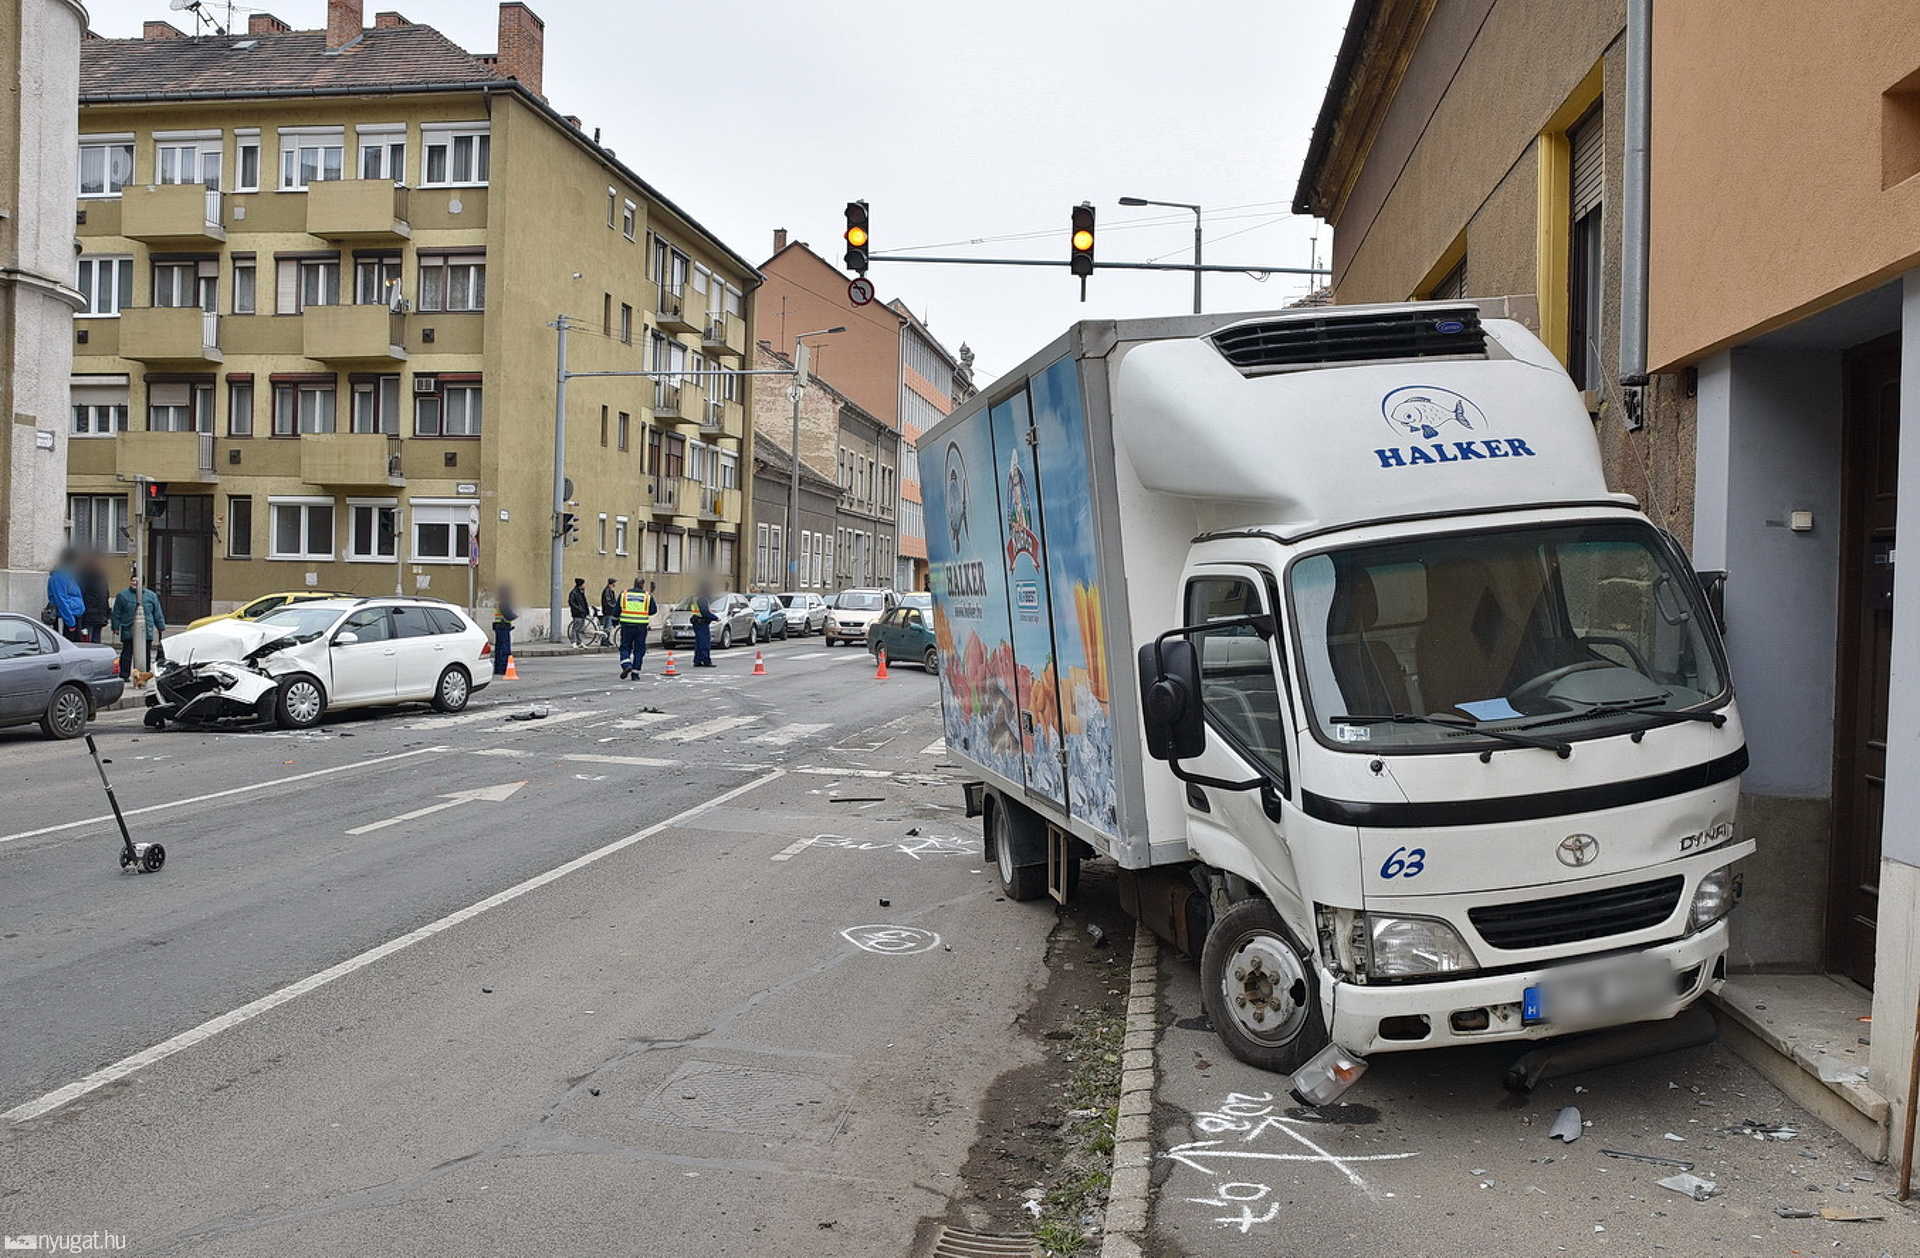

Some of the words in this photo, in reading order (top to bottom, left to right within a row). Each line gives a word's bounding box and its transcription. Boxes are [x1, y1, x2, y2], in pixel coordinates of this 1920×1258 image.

[1374, 437, 1536, 468] HALKER
[945, 561, 987, 597] HALKER
[1380, 847, 1426, 879] 63
[1528, 1006, 1536, 1015] H
